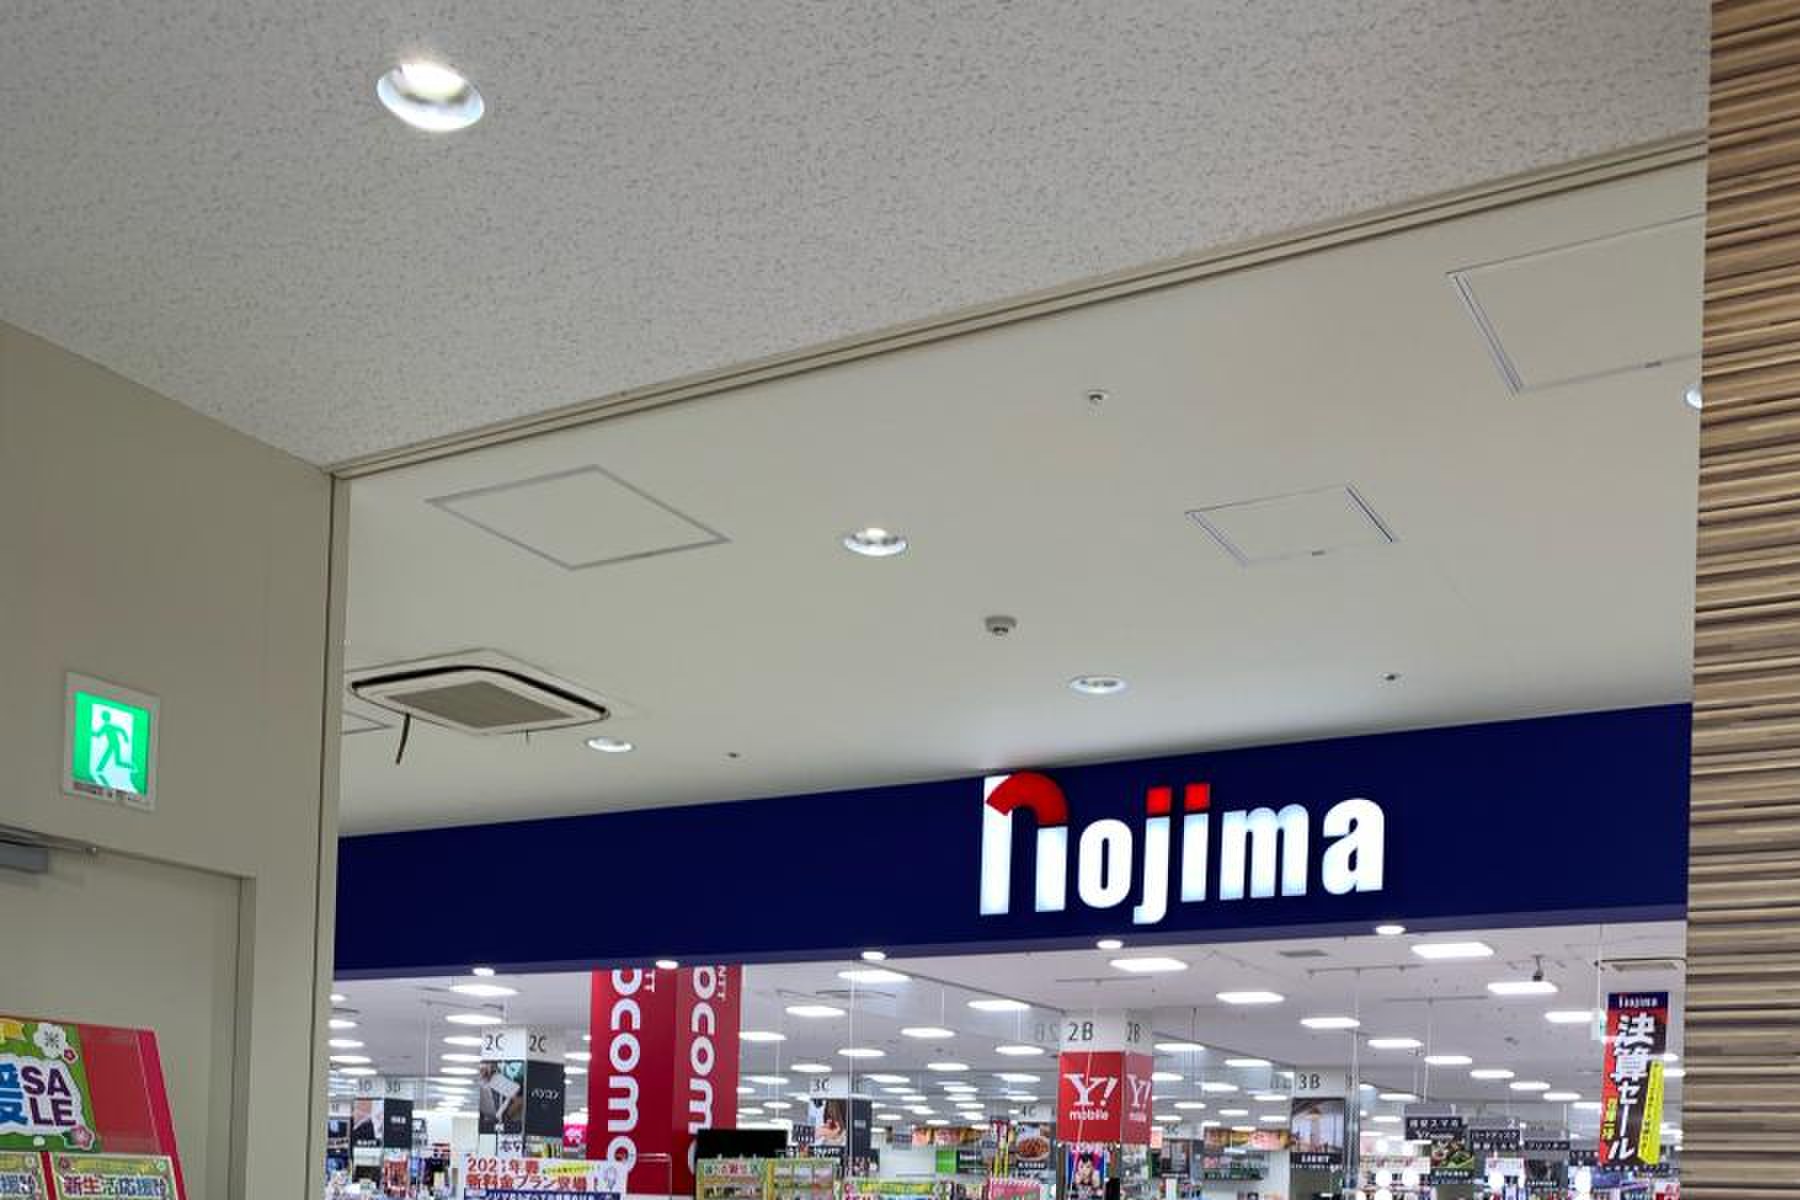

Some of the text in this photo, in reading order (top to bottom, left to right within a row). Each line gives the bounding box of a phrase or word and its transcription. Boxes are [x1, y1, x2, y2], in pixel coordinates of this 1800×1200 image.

[980, 771, 1385, 925] nojima
[485, 1034, 504, 1051] 2C
[529, 1034, 547, 1053] 2C
[1067, 1022, 1093, 1041] 2B
[607, 969, 642, 1175] ocomo
[688, 966, 717, 1175] ocom
[1299, 1074, 1321, 1090] 3B
[1062, 1073, 1119, 1107] Y!
[1605, 1012, 1654, 1160] 決算セール
[1069, 1109, 1109, 1120] mobile
